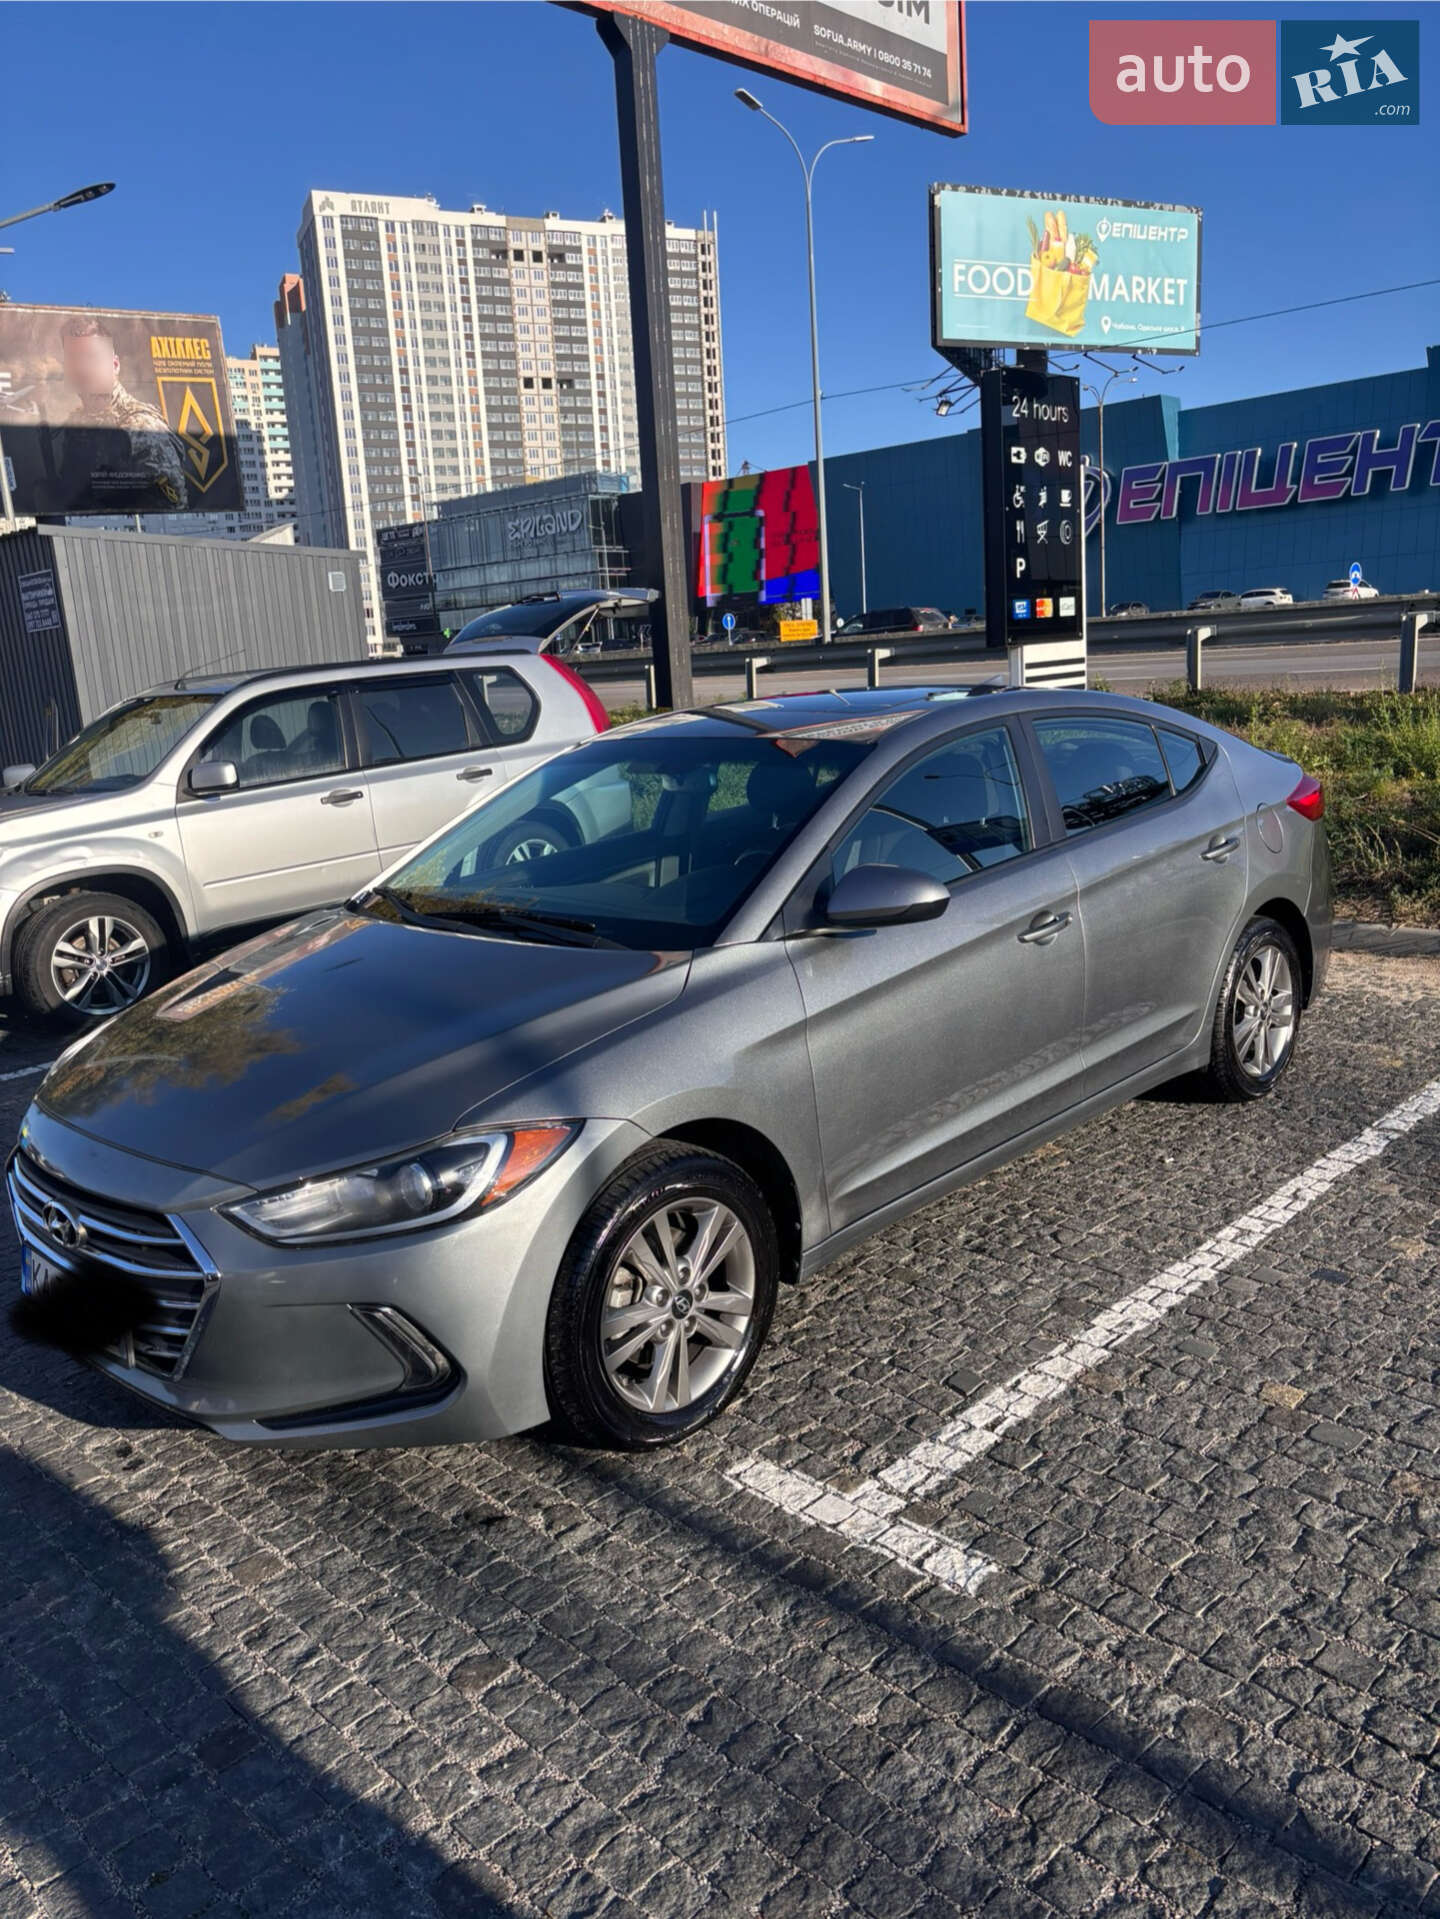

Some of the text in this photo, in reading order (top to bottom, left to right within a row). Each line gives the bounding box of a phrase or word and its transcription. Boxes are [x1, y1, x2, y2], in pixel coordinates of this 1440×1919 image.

[813, 24, 873, 57] SOFUA.ARMY
[878, 50, 901, 67] 0800
[1112, 222, 1188, 242] ЕПІЦЕНТР
[954, 263, 1187, 305] FOOD MARKET
[1012, 395, 1069, 423] 24 hours
[1058, 451, 1072, 467] WC
